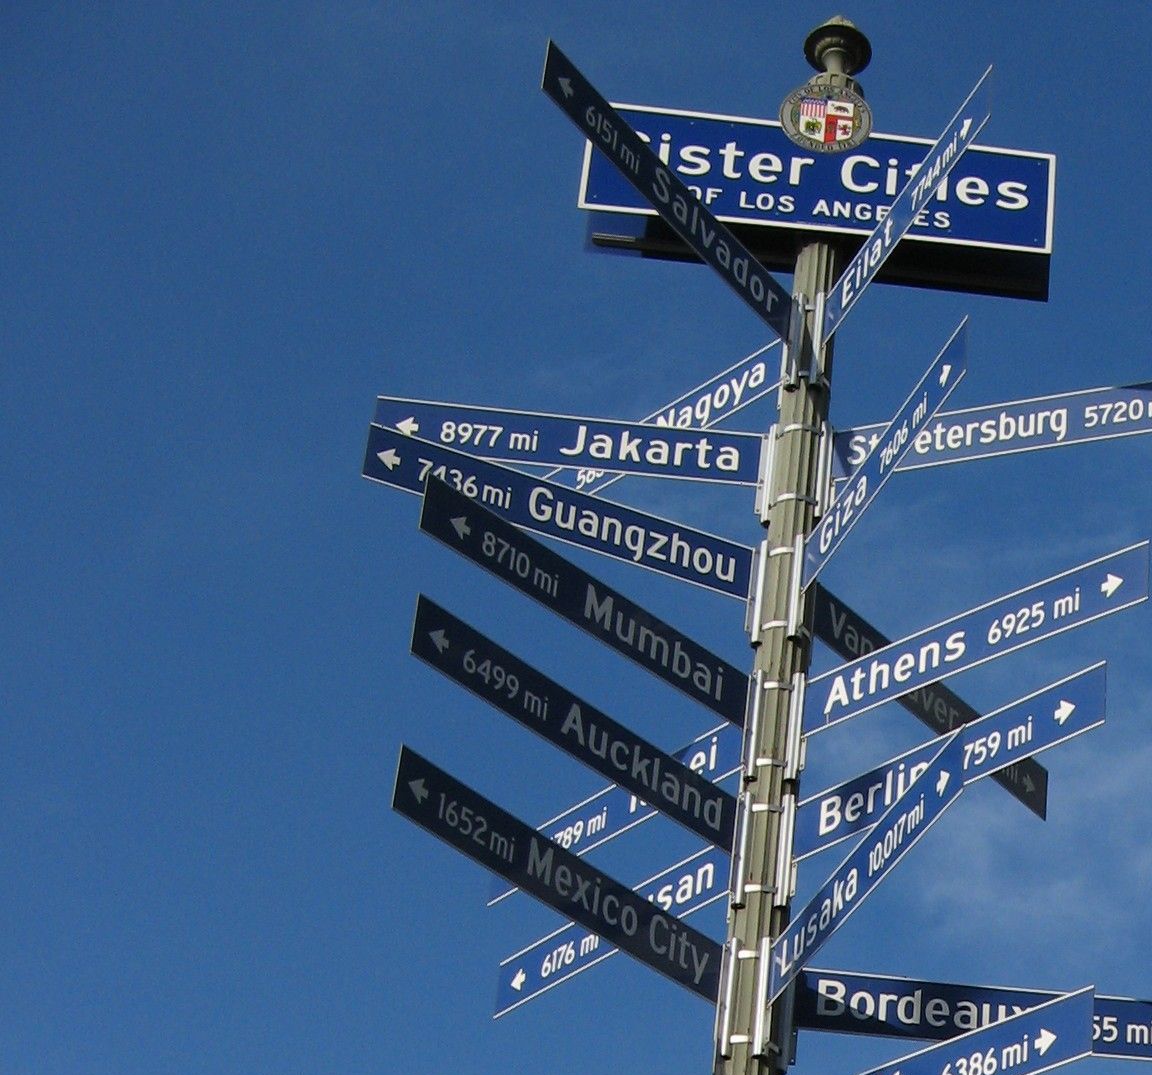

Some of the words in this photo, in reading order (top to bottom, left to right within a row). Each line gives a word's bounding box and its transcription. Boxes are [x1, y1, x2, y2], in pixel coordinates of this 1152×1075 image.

[635, 131, 815, 186] ister
[585, 105, 617, 151] 6151
[620, 141, 641, 174] mi
[652, 166, 779, 313] Salvador
[739, 191, 795, 213] LOS
[812, 199, 950, 228] ANGEES
[842, 219, 893, 309] Eilat
[911, 157, 940, 211] 7744
[942, 132, 957, 168] mi
[440, 420, 504, 449] 8977
[509, 430, 539, 453] mi
[559, 425, 740, 471] Jakarta
[820, 475, 867, 554] Giza
[880, 419, 909, 474] 7606
[912, 391, 927, 428] mi
[914, 408, 1068, 454] etersburg
[1084, 399, 1144, 429] 5720
[482, 484, 512, 509] mi
[528, 486, 736, 583] Guangzhou
[482, 530, 531, 578] 8710
[534, 565, 560, 598] mi
[584, 583, 724, 701] Mumbai
[824, 631, 966, 715] Athens
[987, 601, 1045, 645] 6925
[1053, 588, 1080, 619] mi
[462, 649, 520, 698] 6499
[524, 690, 548, 721] mi
[560, 703, 722, 831] Auckland
[1007, 715, 1033, 750] mi
[550, 821, 584, 849] 789
[586, 806, 607, 837] mi
[436, 793, 487, 847] 1652
[490, 831, 516, 864] mi
[527, 837, 638, 936] Mexico
[650, 914, 710, 985] City
[780, 868, 858, 977] Lusaka
[907, 793, 924, 834] mi
[541, 941, 575, 978] 6176
[1001, 1034, 1029, 1070] mi
